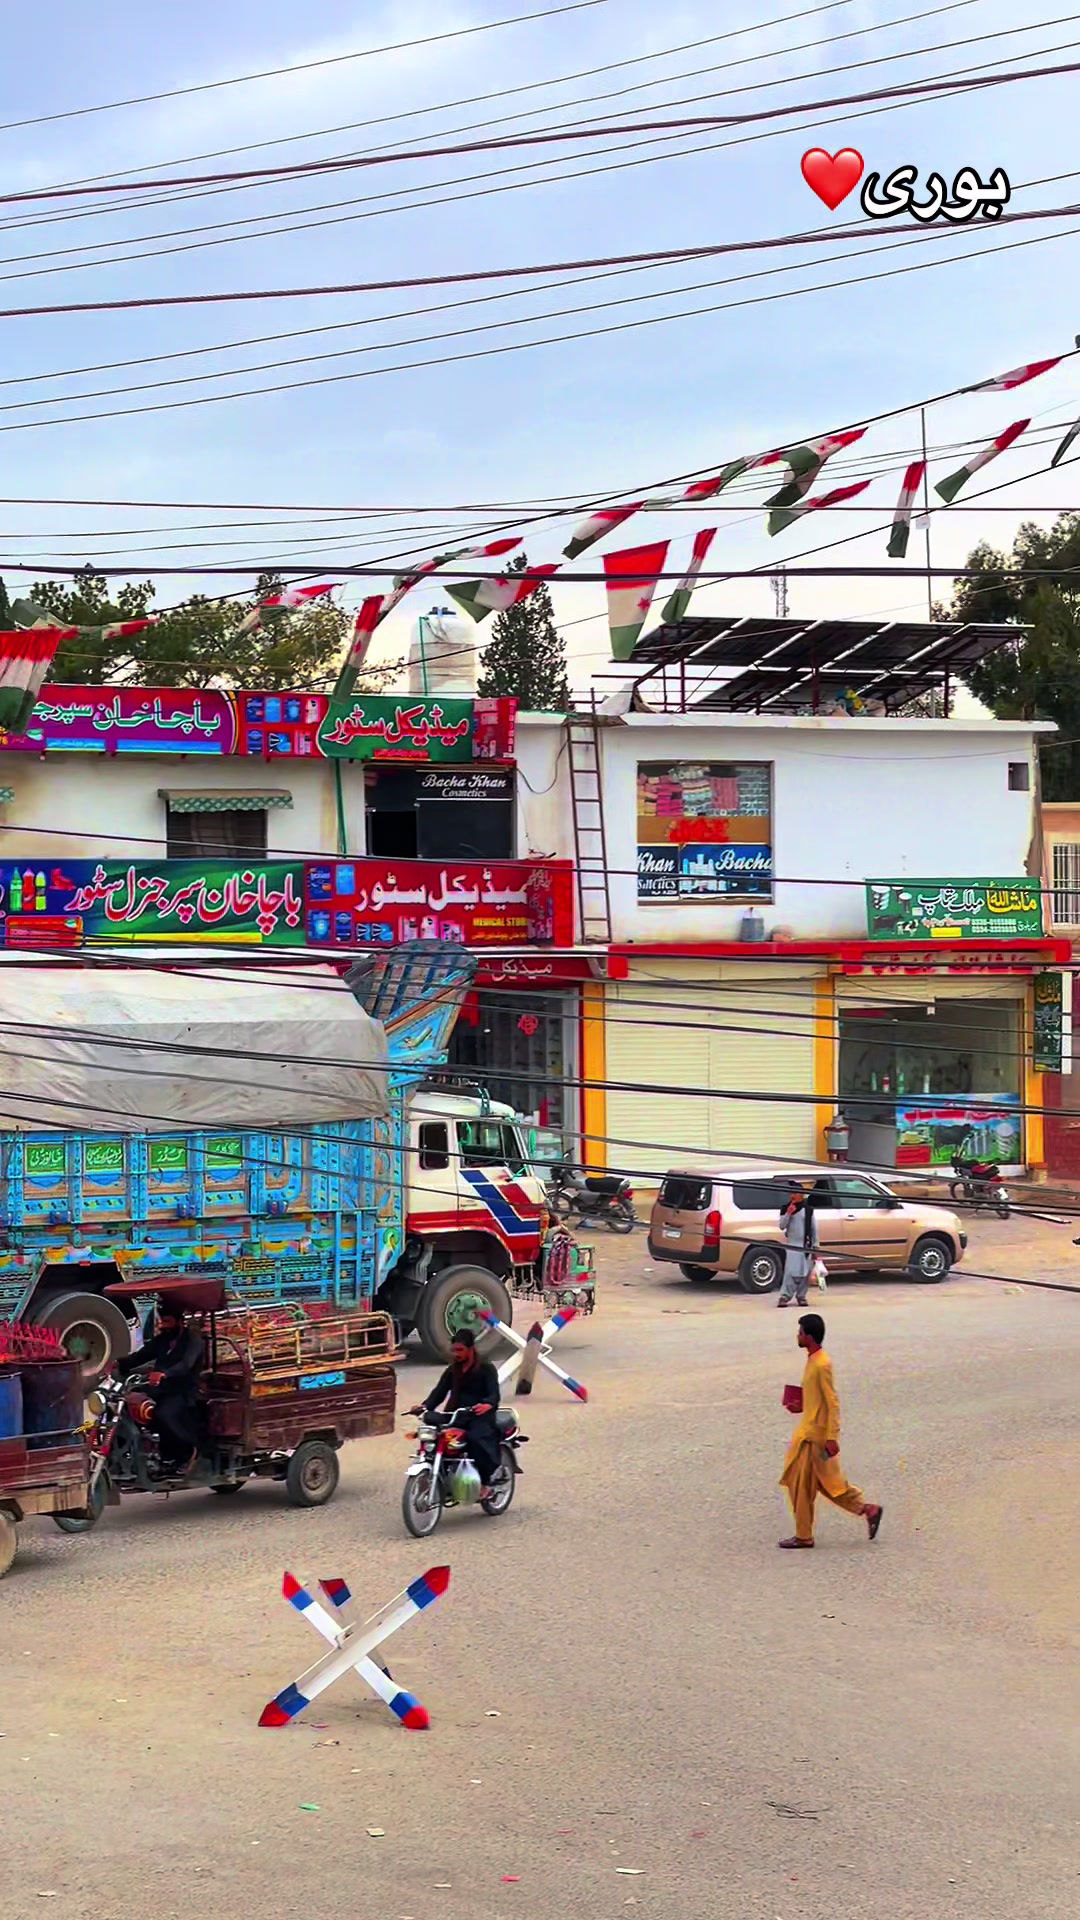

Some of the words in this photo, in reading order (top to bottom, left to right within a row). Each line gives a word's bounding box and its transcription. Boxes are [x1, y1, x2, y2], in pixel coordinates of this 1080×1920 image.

[421, 773, 468, 788] Bacha
[467, 774, 507, 788] Khan
[442, 787, 487, 798] Cosmetics
